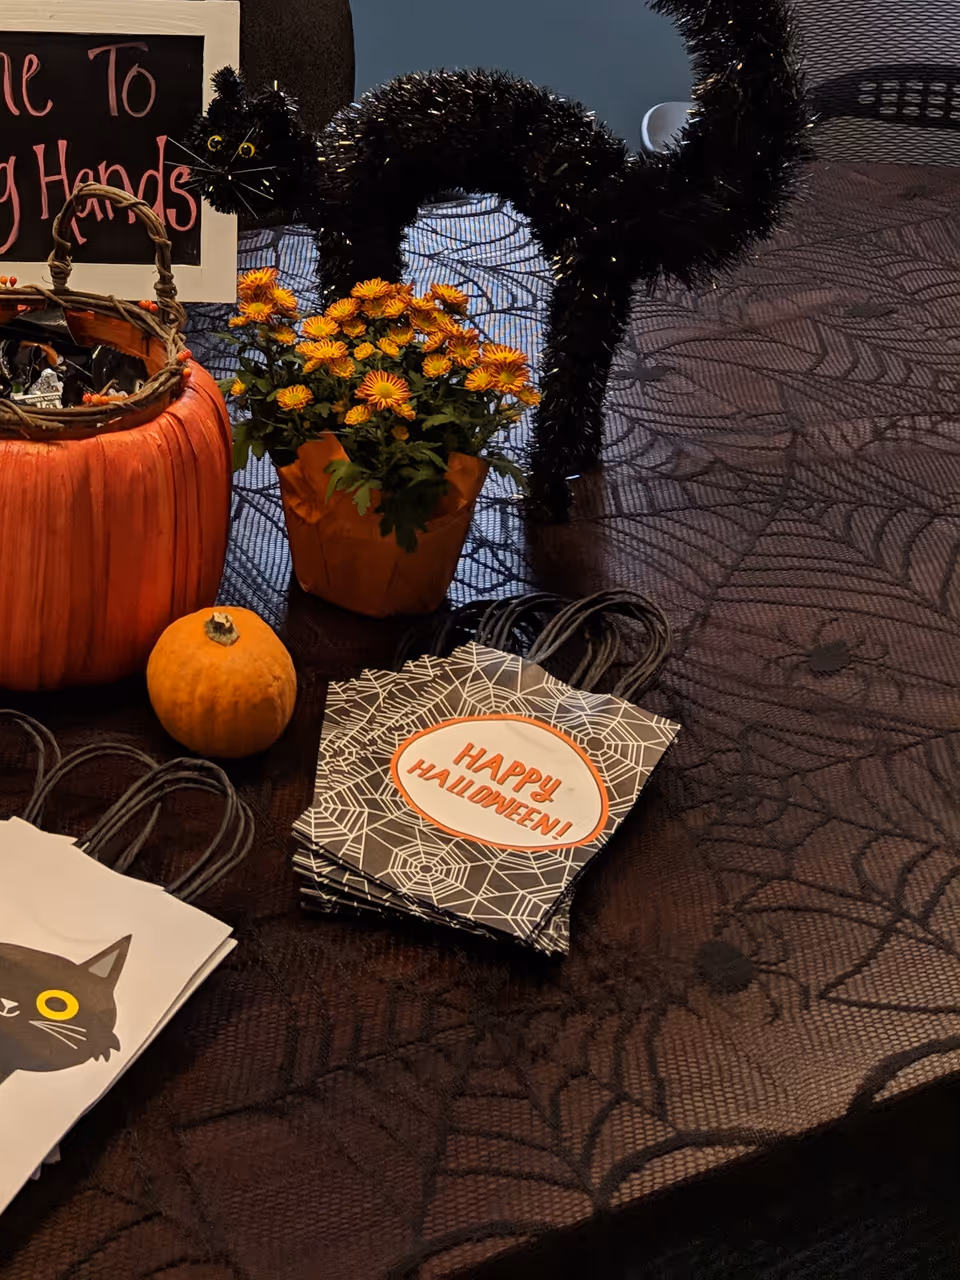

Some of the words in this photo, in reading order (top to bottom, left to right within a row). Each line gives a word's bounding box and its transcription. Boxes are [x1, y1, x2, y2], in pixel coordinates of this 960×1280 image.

[88, 41, 157, 118] To
[33, 134, 198, 246] Hands
[406, 758, 574, 841] HALLOWEEN!
[452, 741, 563, 804] HAPPY
